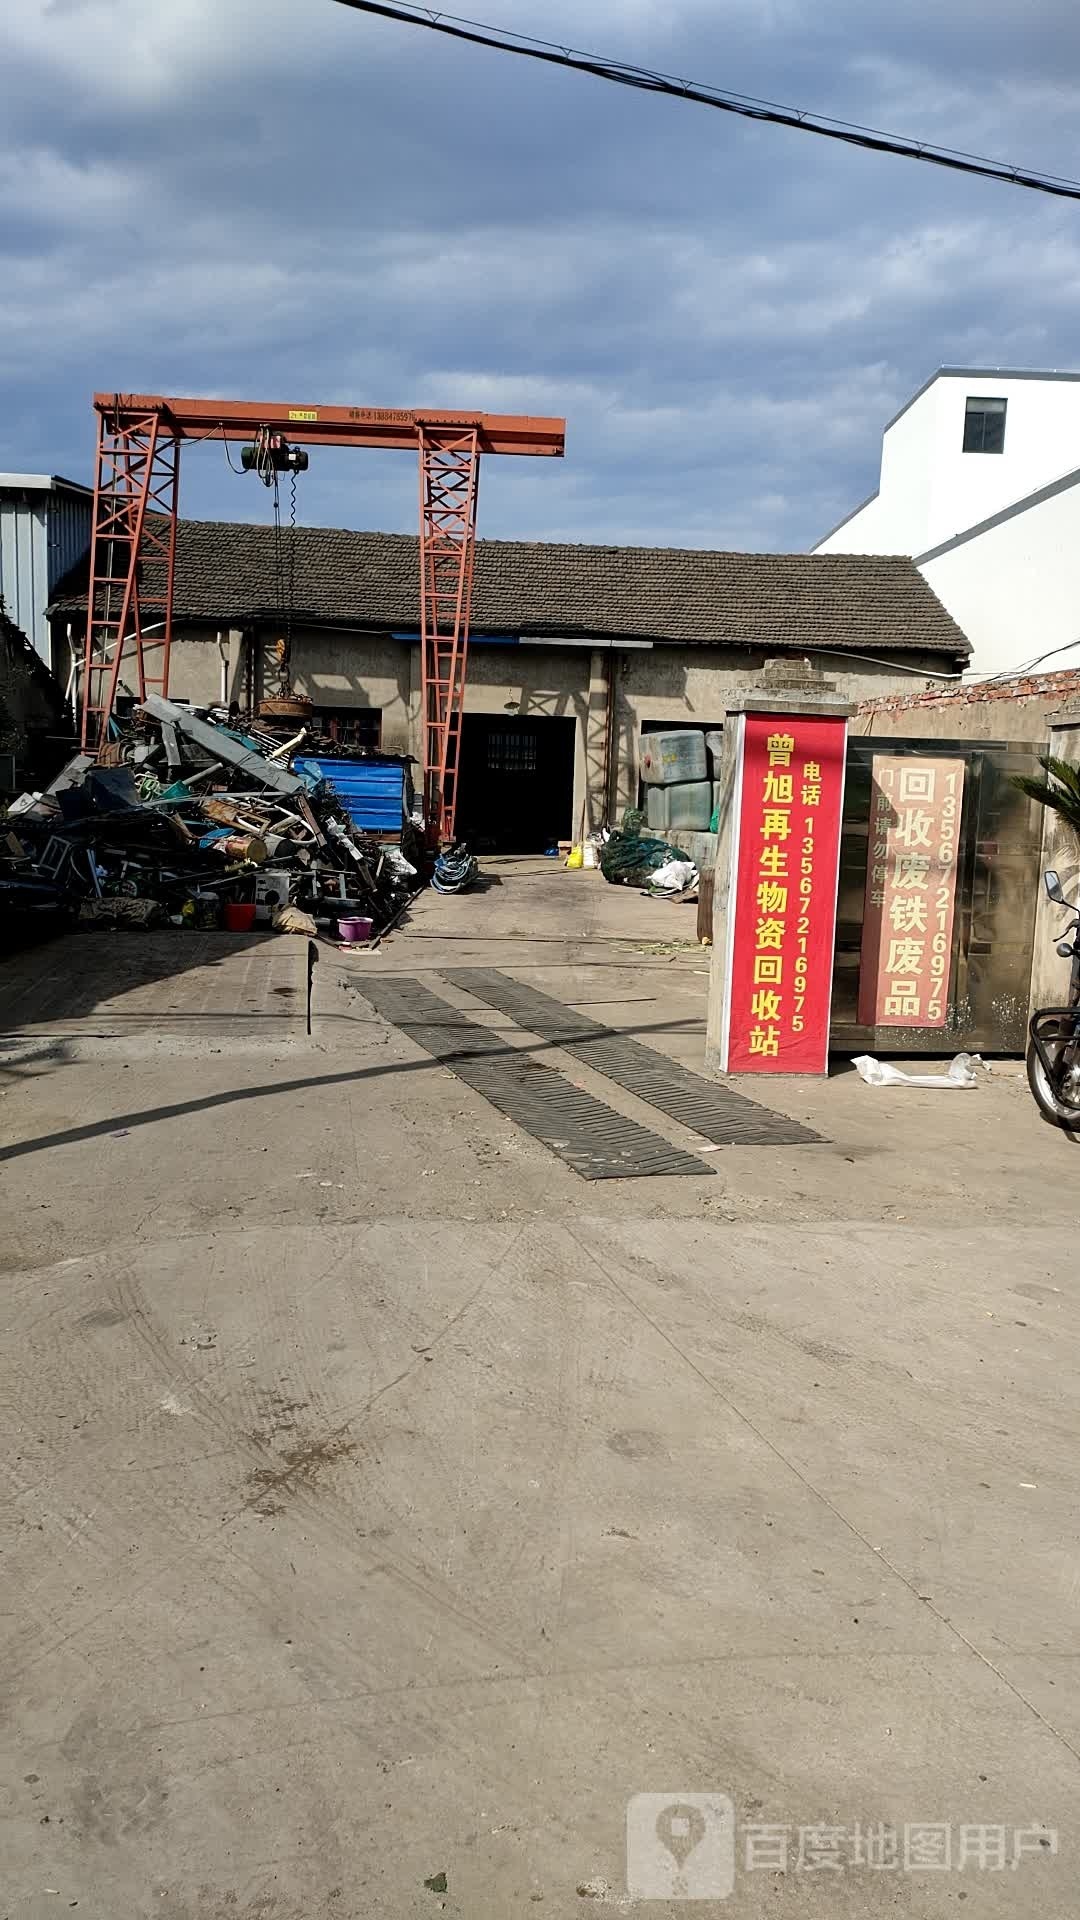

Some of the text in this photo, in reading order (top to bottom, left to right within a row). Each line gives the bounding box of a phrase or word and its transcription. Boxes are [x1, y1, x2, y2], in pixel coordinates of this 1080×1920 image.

[748, 733, 795, 1057] 曾旭再生物资回收站
[791, 761, 822, 1032] 电话 13567216975
[869, 768, 894, 909] 门前请勿停车
[884, 767, 935, 1017] 回收废铁废品
[927, 771, 956, 1020] 13567216975
